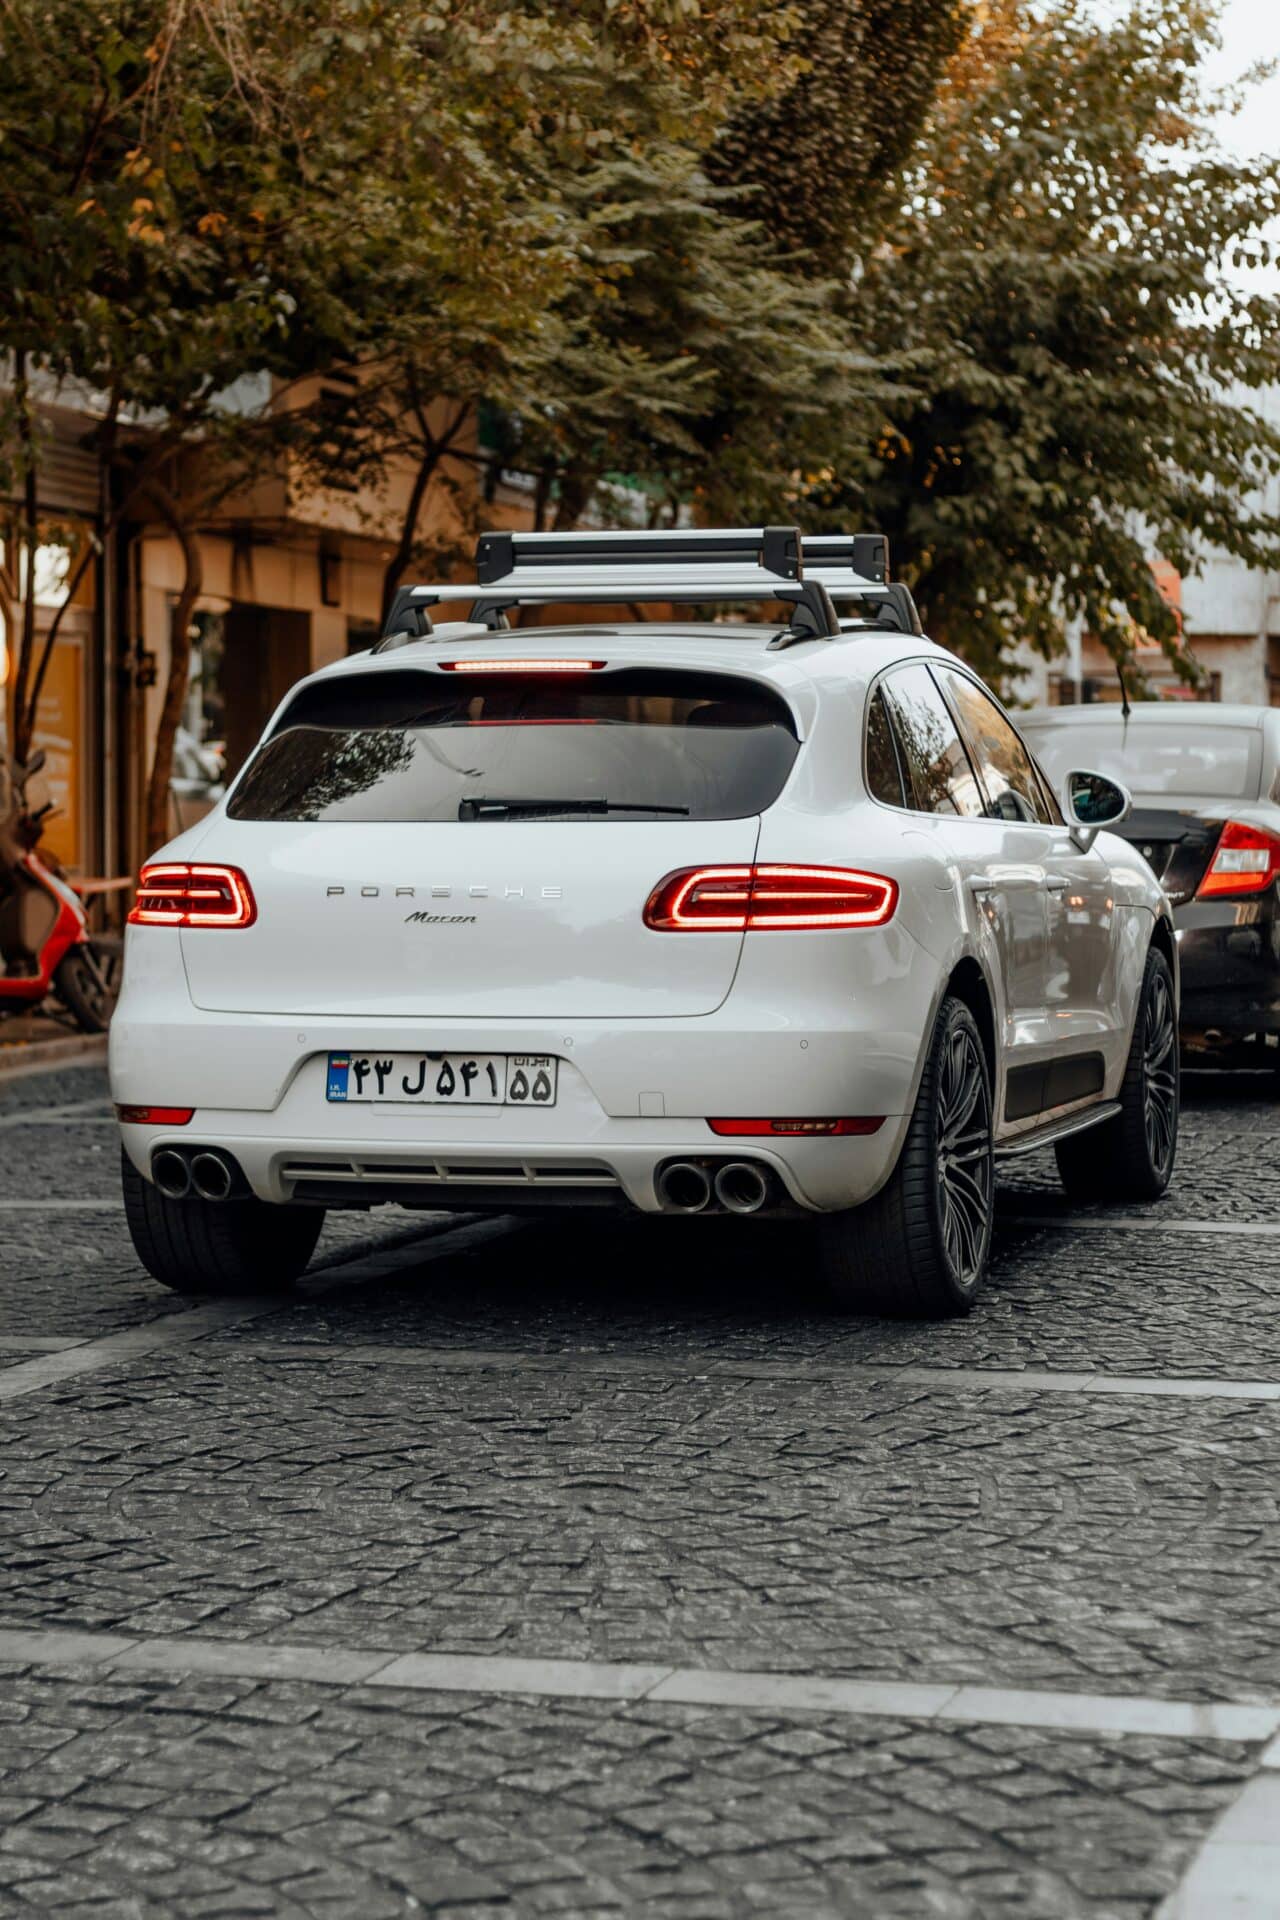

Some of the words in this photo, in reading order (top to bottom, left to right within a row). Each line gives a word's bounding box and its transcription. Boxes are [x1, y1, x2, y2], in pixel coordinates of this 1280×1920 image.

[326, 885, 563, 898] PORSCHE
[404, 911, 477, 924] Macan
[510, 1069, 552, 1102] ۵۵
